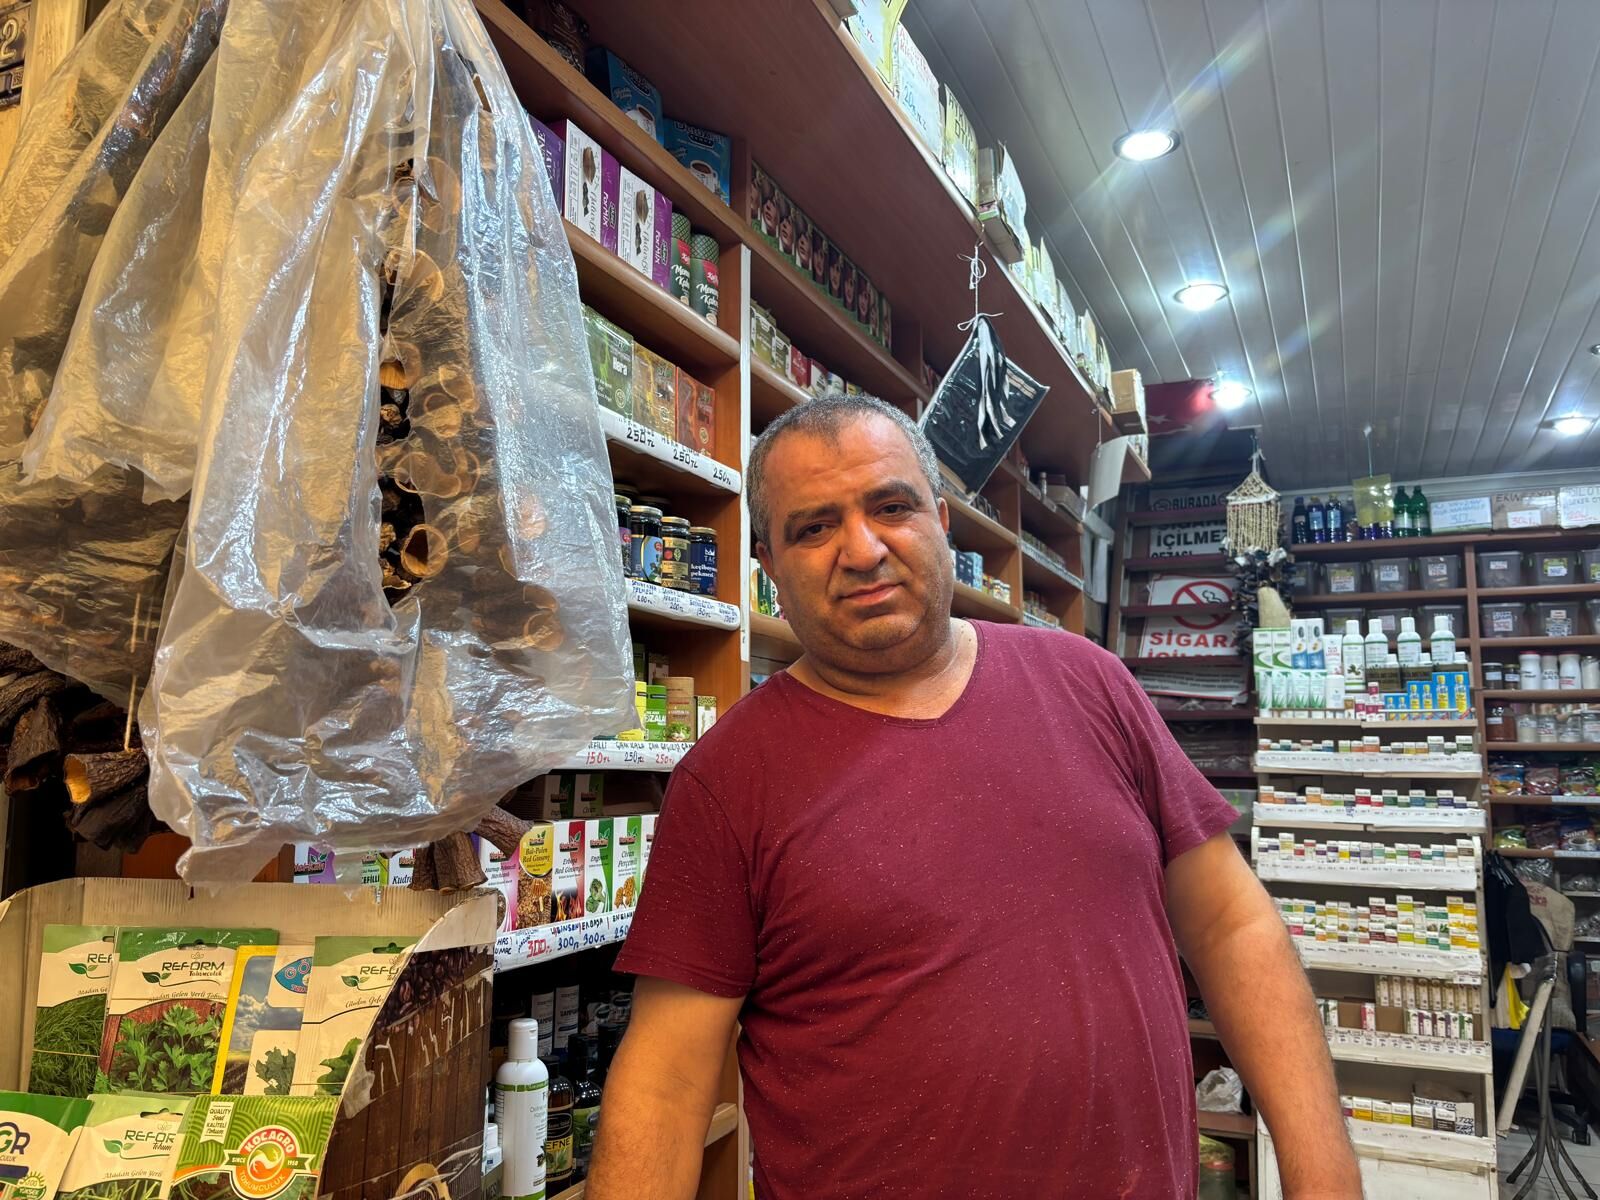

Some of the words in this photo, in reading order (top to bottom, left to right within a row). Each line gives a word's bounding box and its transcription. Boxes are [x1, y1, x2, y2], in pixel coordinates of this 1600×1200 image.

[161, 961, 225, 971] REFORM
[244, 1129, 295, 1154] KOCAGRO
[545, 1136, 571, 1150] EFNE
[231, 1156, 247, 1164] SINCE
[238, 1170, 285, 1192] TOHUMCULUK
